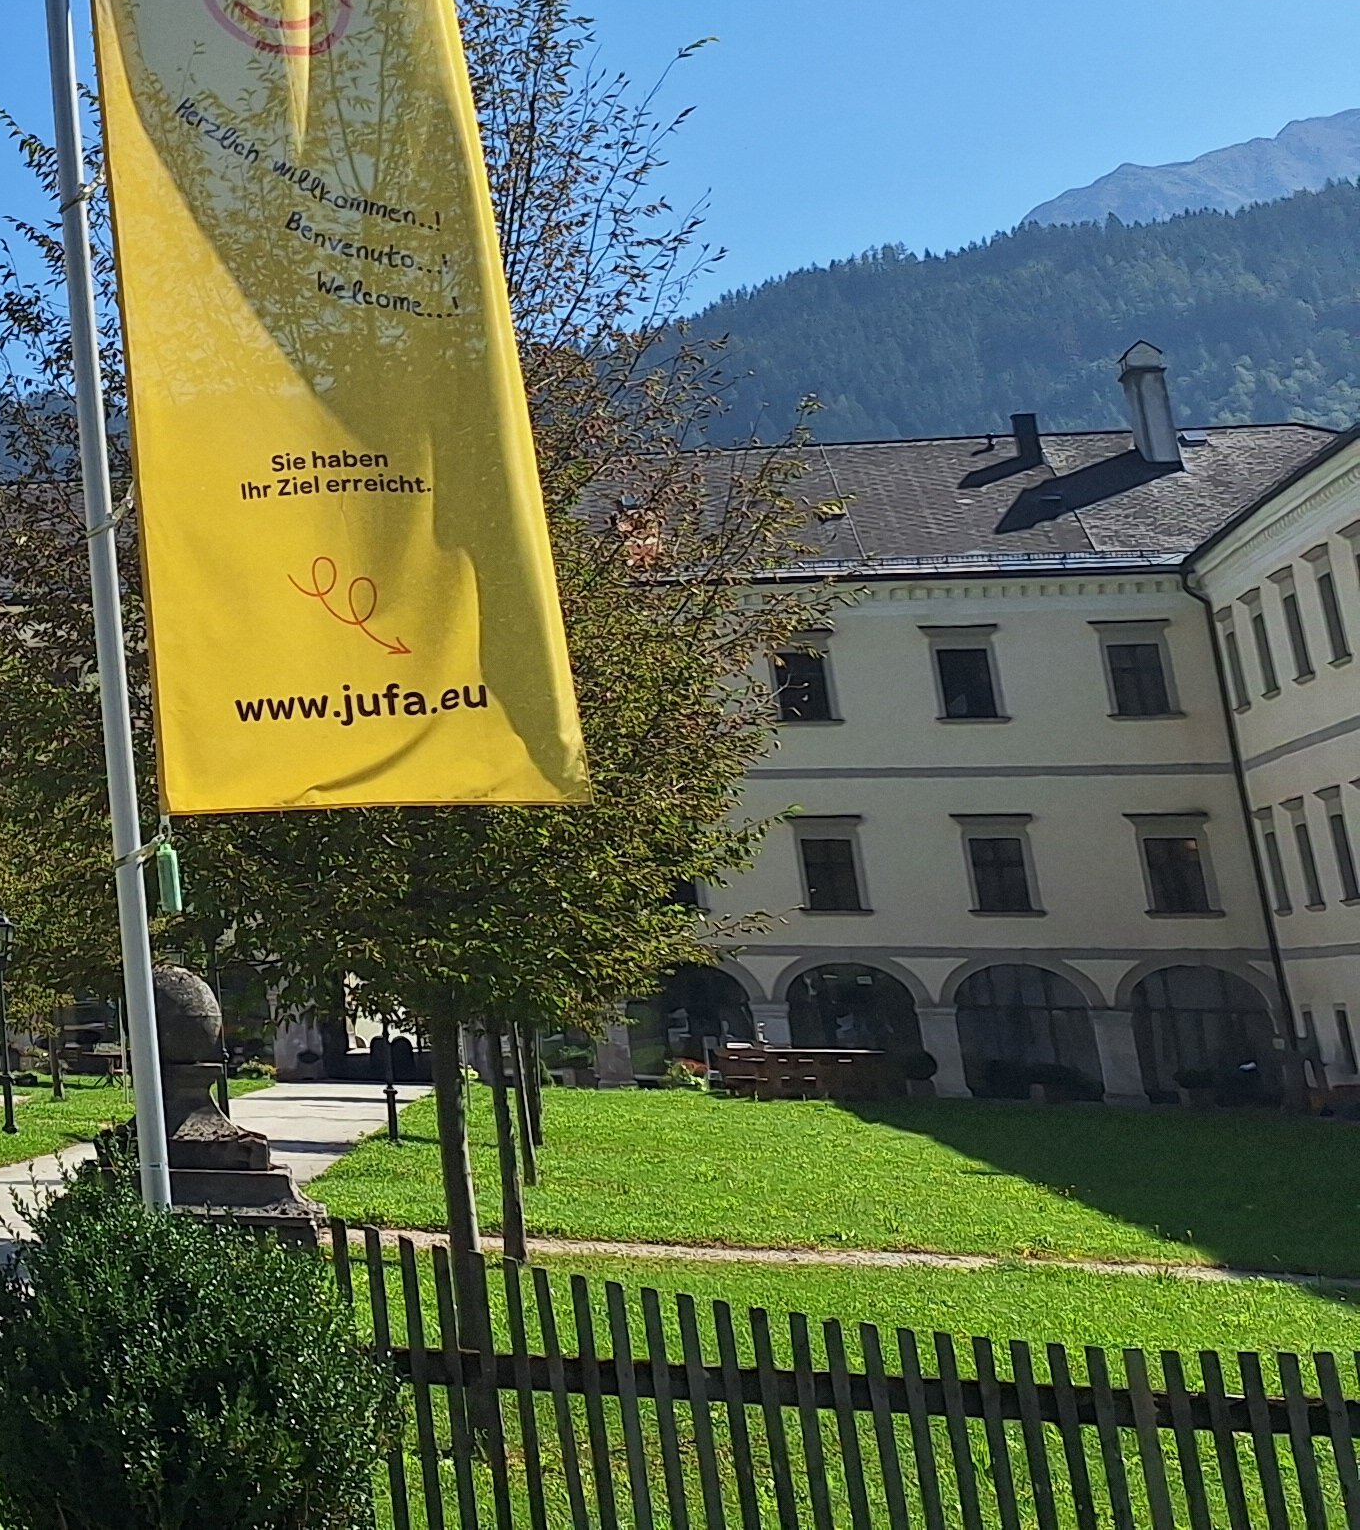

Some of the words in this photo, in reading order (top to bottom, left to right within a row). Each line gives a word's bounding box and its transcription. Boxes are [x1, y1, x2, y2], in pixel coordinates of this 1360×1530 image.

[175, 97, 259, 165] Herzlich
[271, 452, 306, 472] Sie
[311, 450, 389, 469] haben
[240, 482, 271, 501] Ihr
[276, 476, 319, 496] Ziel
[326, 474, 432, 494] erreicht.
[234, 683, 489, 726] www.jufa.eu
